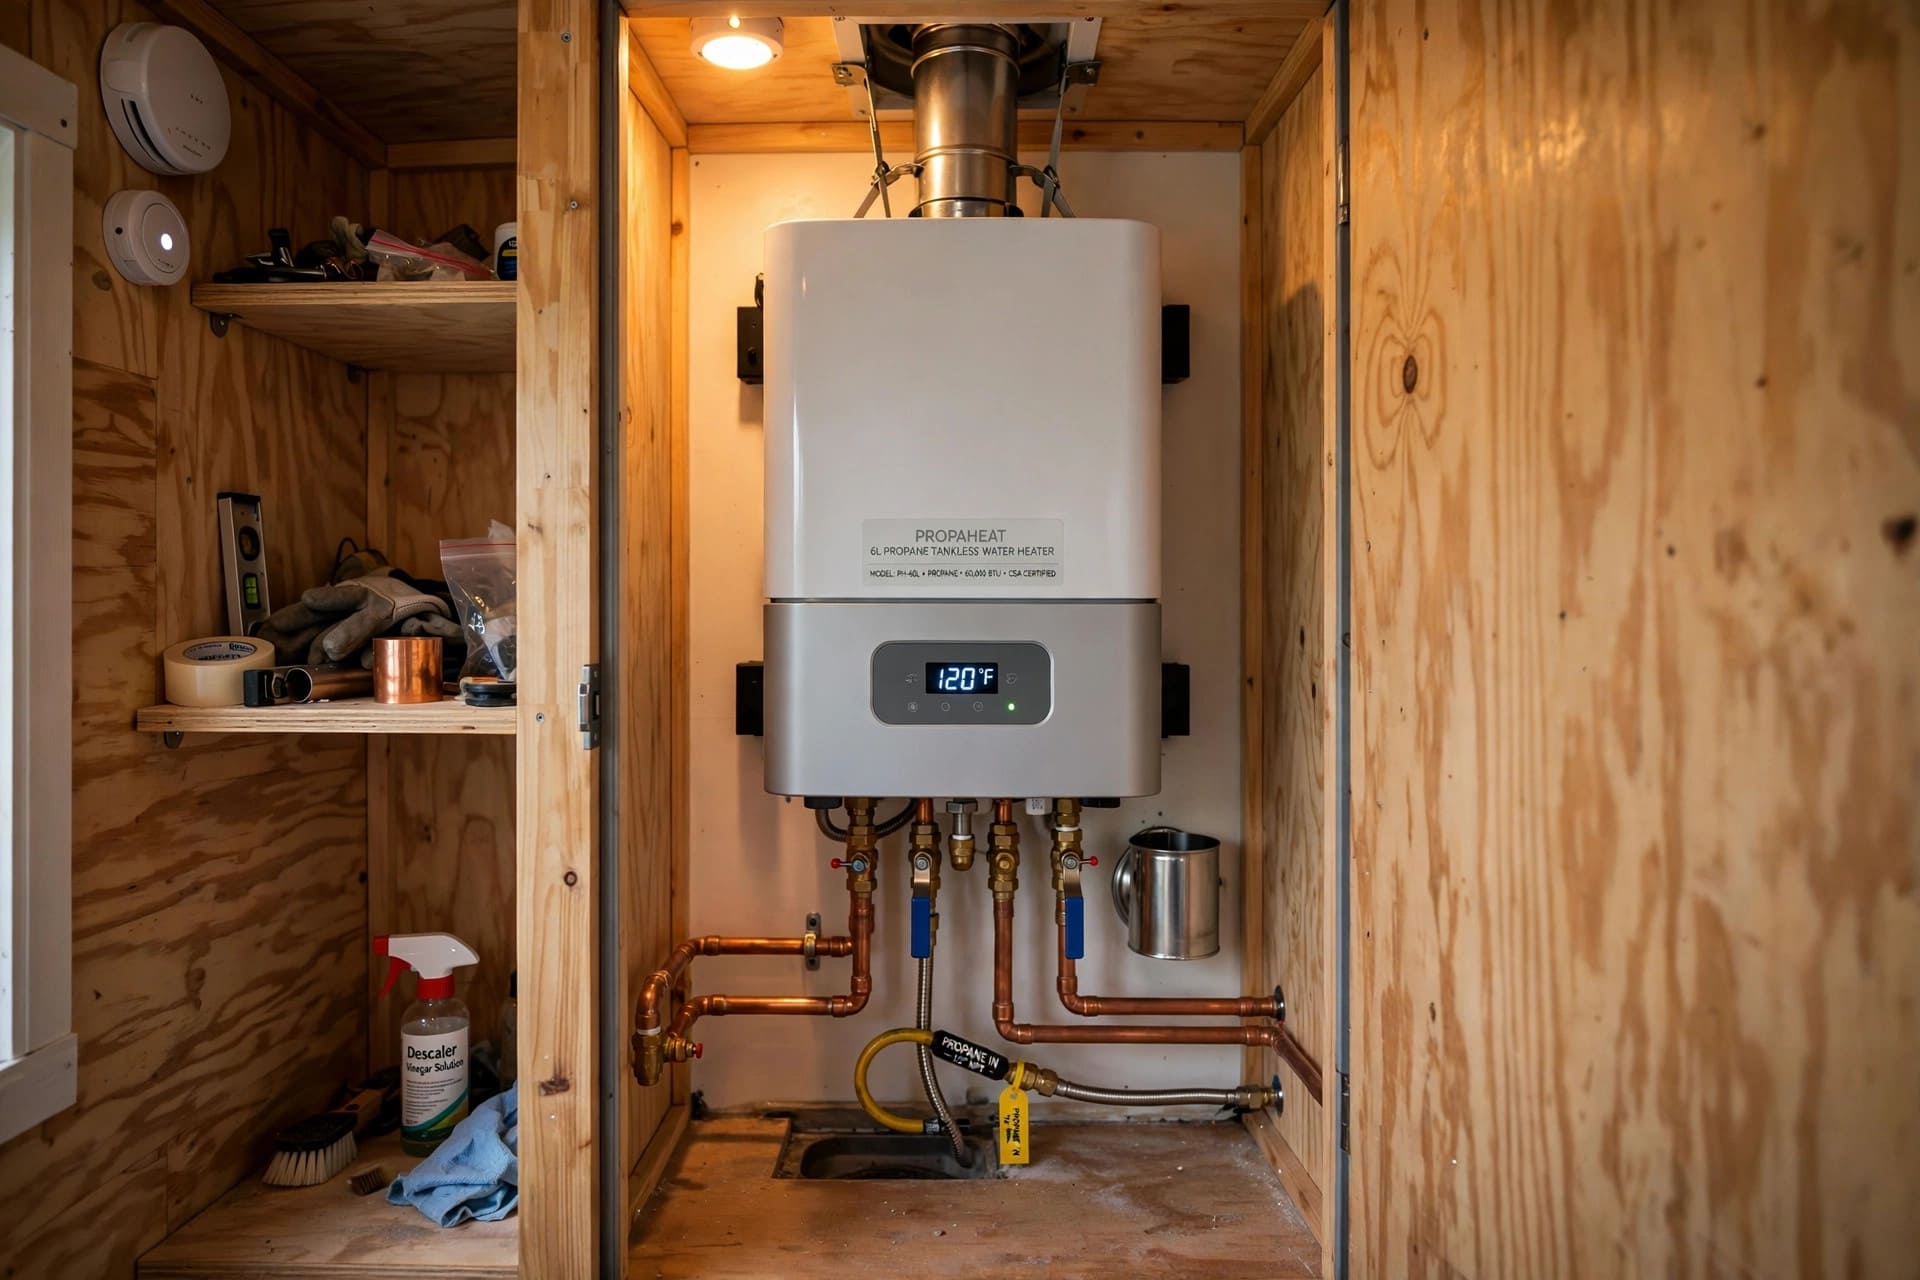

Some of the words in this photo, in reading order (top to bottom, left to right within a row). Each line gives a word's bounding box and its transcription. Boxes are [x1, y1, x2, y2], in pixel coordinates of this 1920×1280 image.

[915, 529, 1006, 543] PROPAHEAT
[870, 546, 882, 556] 6L
[883, 546, 929, 556] PROPANE
[931, 546, 979, 556] TANKLESS
[982, 546, 1015, 556] WATER
[1017, 546, 1055, 556] HEATER
[927, 569, 958, 578] PROPANE
[988, 569, 1001, 578] BTU
[1008, 569, 1022, 578] CSA
[1022, 569, 1056, 578] CERTIFIED
[407, 1044, 457, 1060] Descaler
[941, 1036, 986, 1064] PROPANE
[988, 1055, 1000, 1069] IN
[434, 1058, 464, 1072] Solution
